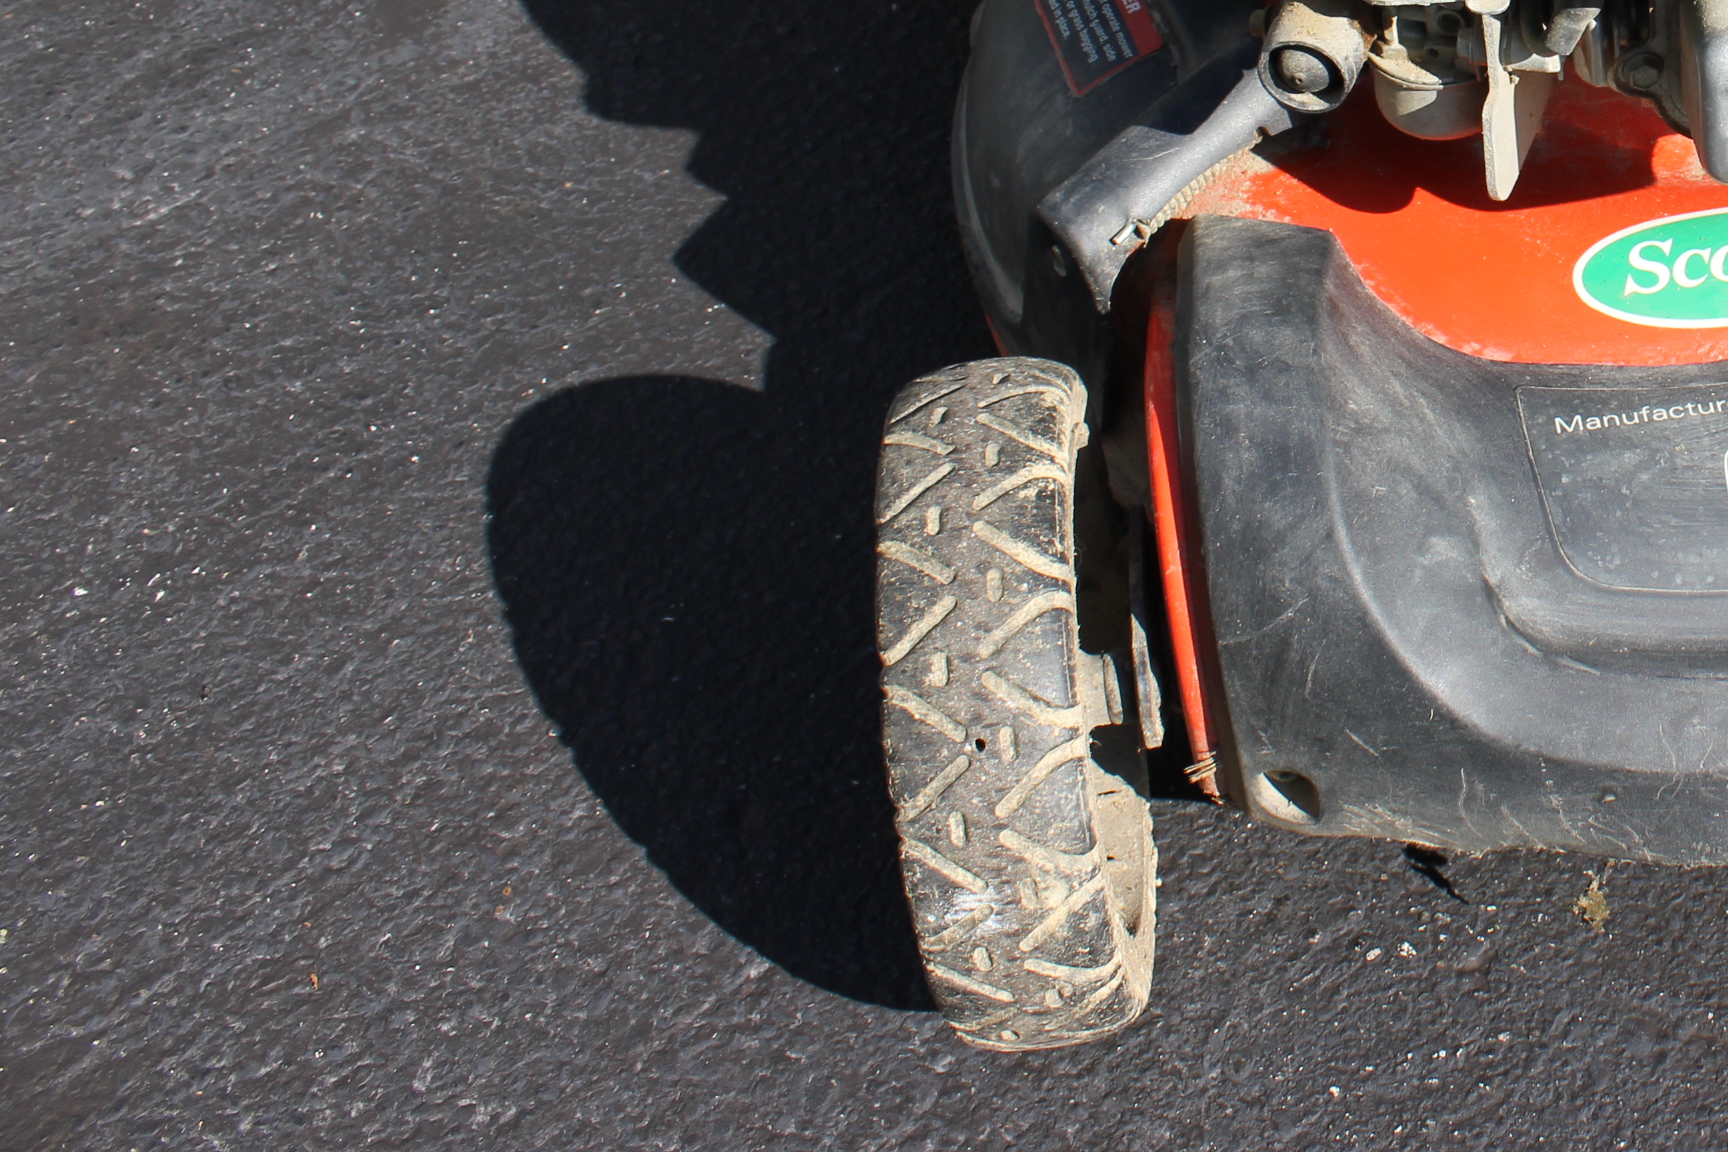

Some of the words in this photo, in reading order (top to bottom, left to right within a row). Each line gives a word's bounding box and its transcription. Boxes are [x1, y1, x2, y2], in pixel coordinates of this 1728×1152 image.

[1066, 0, 1076, 10] or
[1055, 16, 1070, 40] place.
[1068, 9, 1084, 31] grass
[1100, 3, 1120, 32] operate
[1115, 32, 1132, 58] mower
[1077, 29, 1099, 62] bagging
[1103, 44, 1116, 61] side
